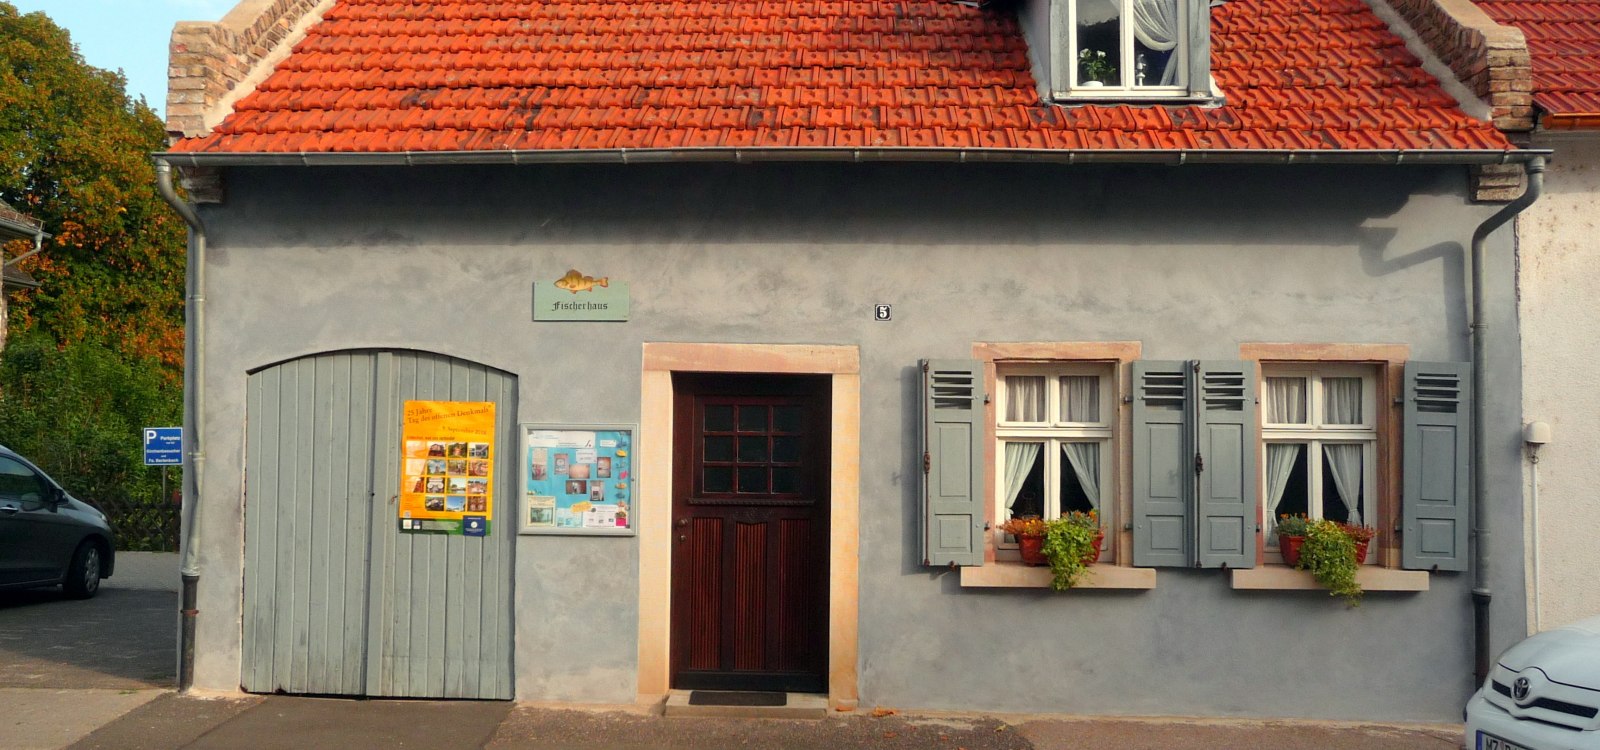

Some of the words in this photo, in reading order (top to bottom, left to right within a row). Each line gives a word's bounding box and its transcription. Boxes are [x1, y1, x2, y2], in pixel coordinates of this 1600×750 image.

[552, 301, 608, 311] Fischerhaus
[879, 306, 888, 318] 5
[415, 408, 432, 416] Jahre
[146, 430, 157, 444] P
